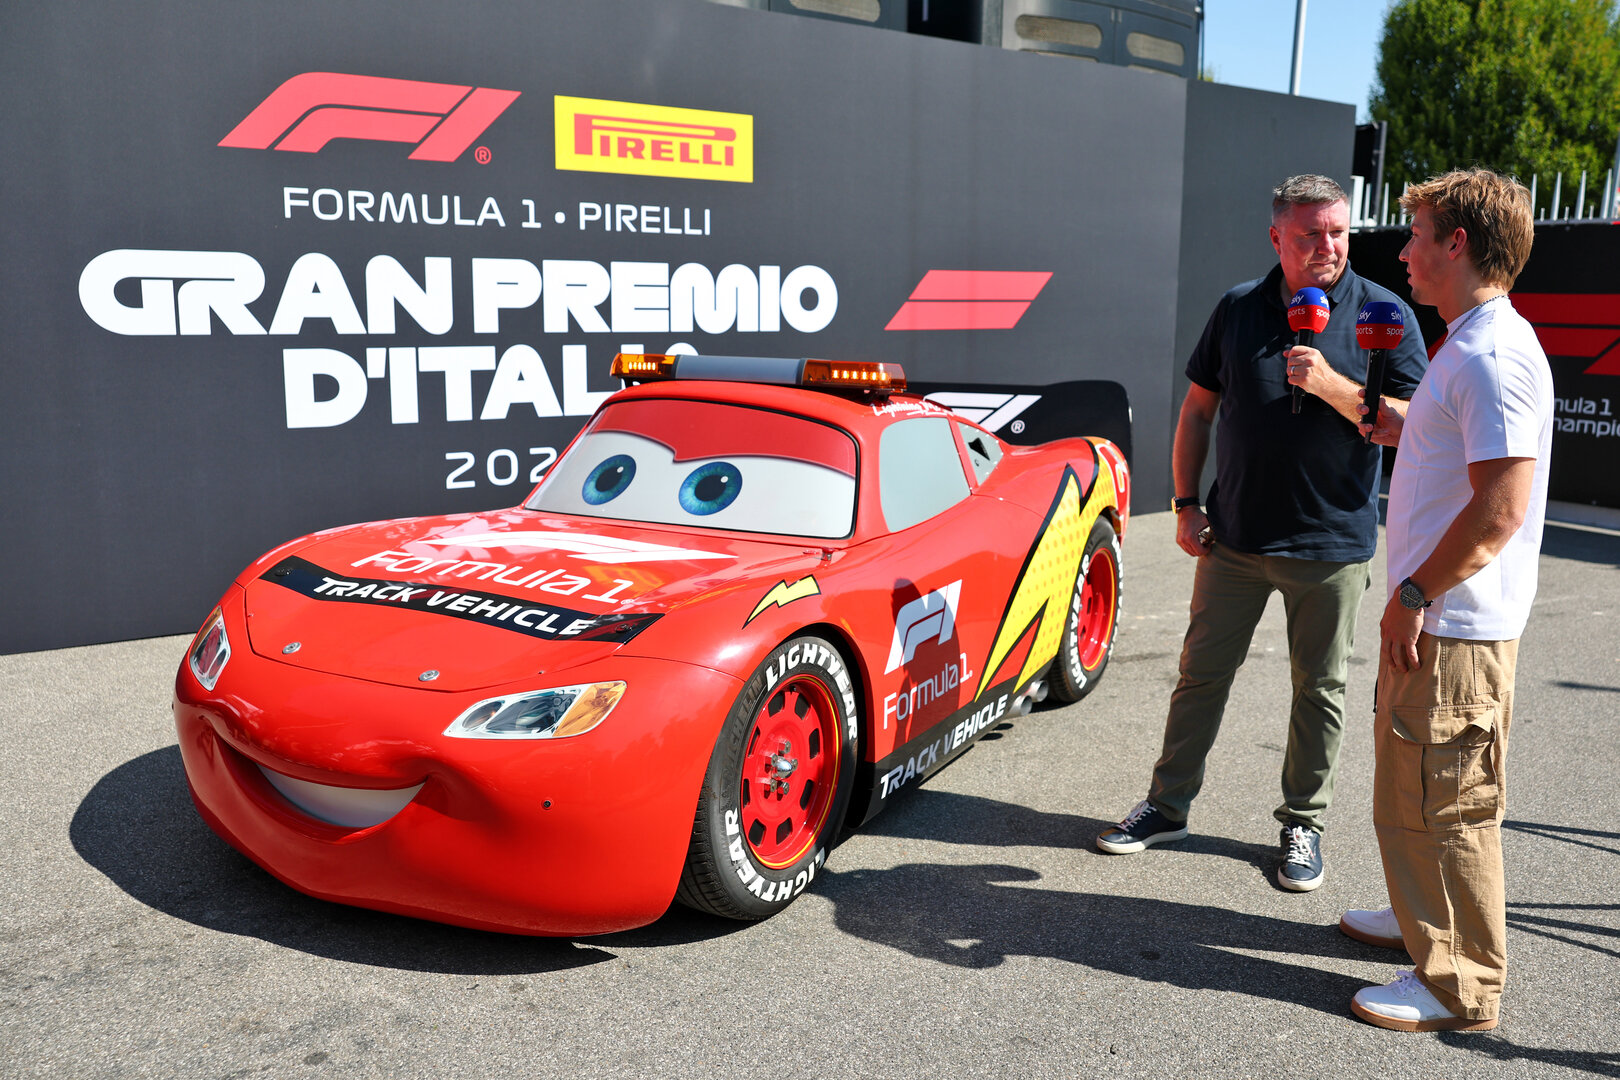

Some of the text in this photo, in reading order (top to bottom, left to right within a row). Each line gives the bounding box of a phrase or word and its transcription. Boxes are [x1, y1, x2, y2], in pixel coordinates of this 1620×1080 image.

[574, 113, 737, 167] PIRELLI
[283, 187, 711, 236] FORMULA 1 PIRELLI
[78, 249, 838, 336] GRAN PREMIO
[1287, 308, 1306, 318] ports
[1291, 295, 1304, 304] sky
[1358, 310, 1372, 322] sky
[283, 342, 699, 429] D'ITAL
[1599, 398, 1613, 417] 1
[445, 447, 558, 490] 202
[313, 576, 597, 637] TRACK VEHICLE
[766, 643, 858, 740] LIGHTYEAR
[880, 694, 1009, 800] TRACK VEHICLE
[725, 807, 826, 902] LIGHTYEAR
